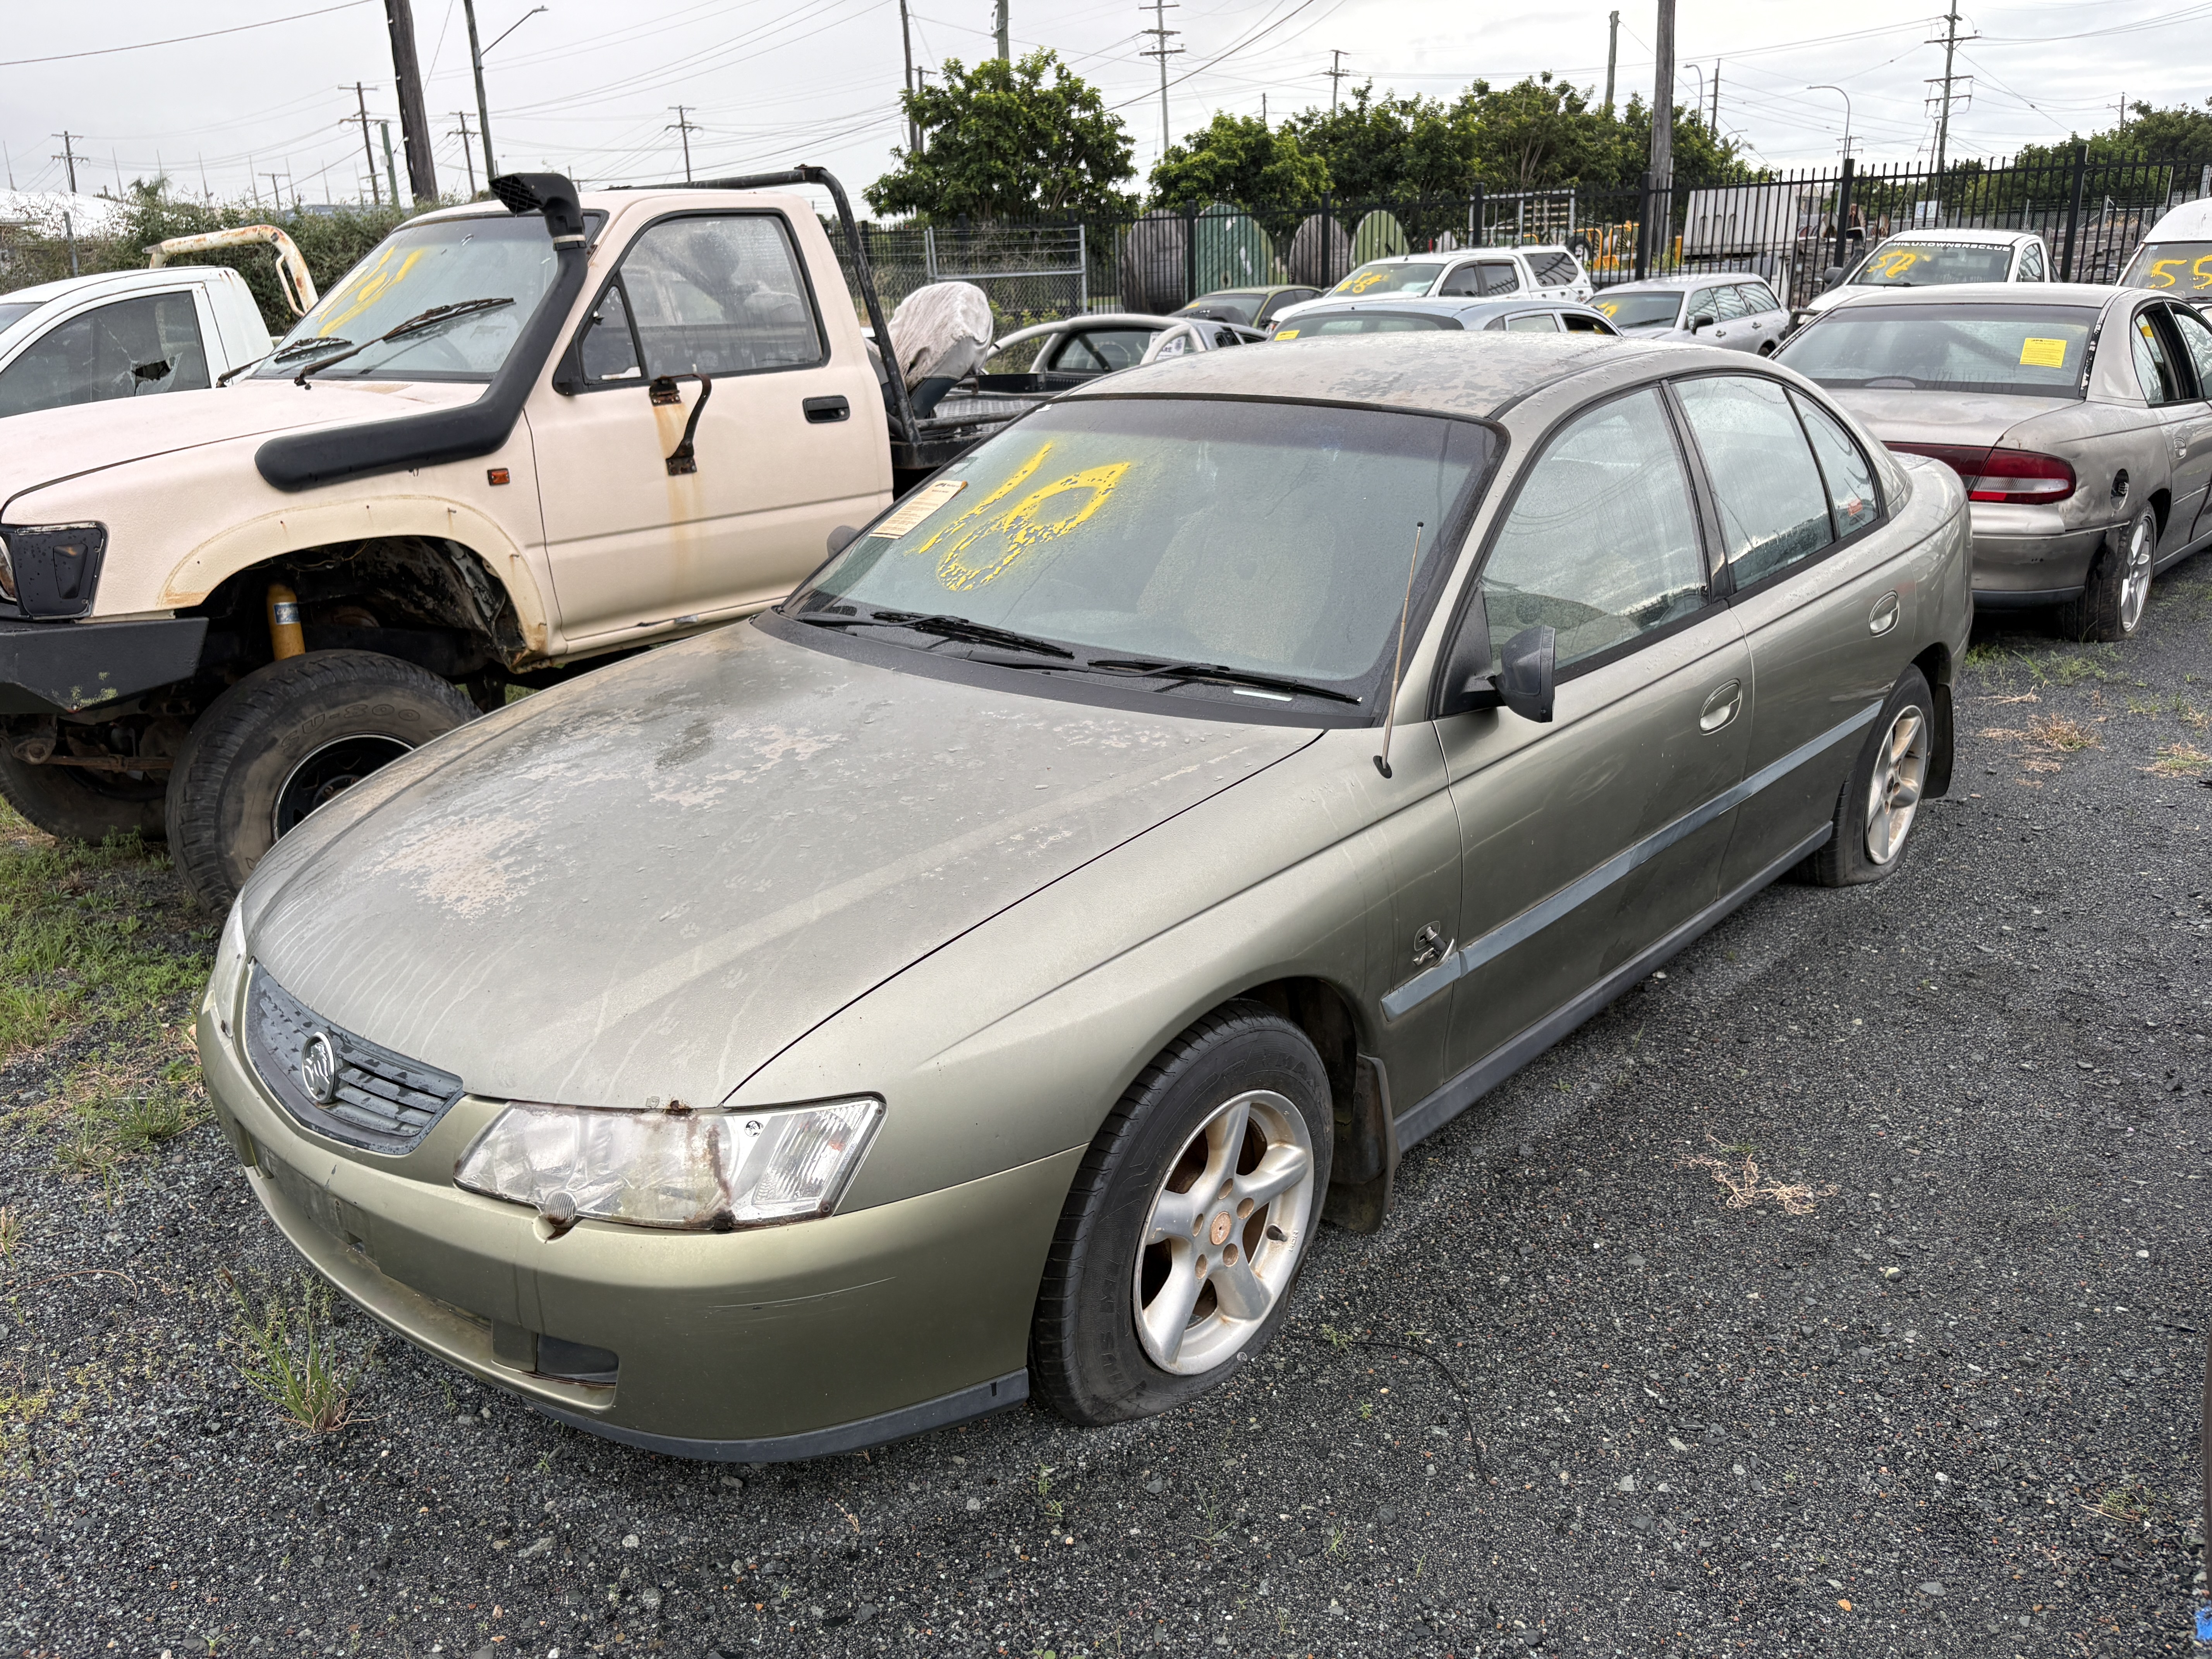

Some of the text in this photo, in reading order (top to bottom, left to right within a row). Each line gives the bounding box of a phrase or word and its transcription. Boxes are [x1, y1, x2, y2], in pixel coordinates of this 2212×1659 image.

[1893, 242, 2011, 252] HILUXOWNERSCLUB
[2147, 254, 2212, 290] 55
[281, 704, 421, 754] SU-800
